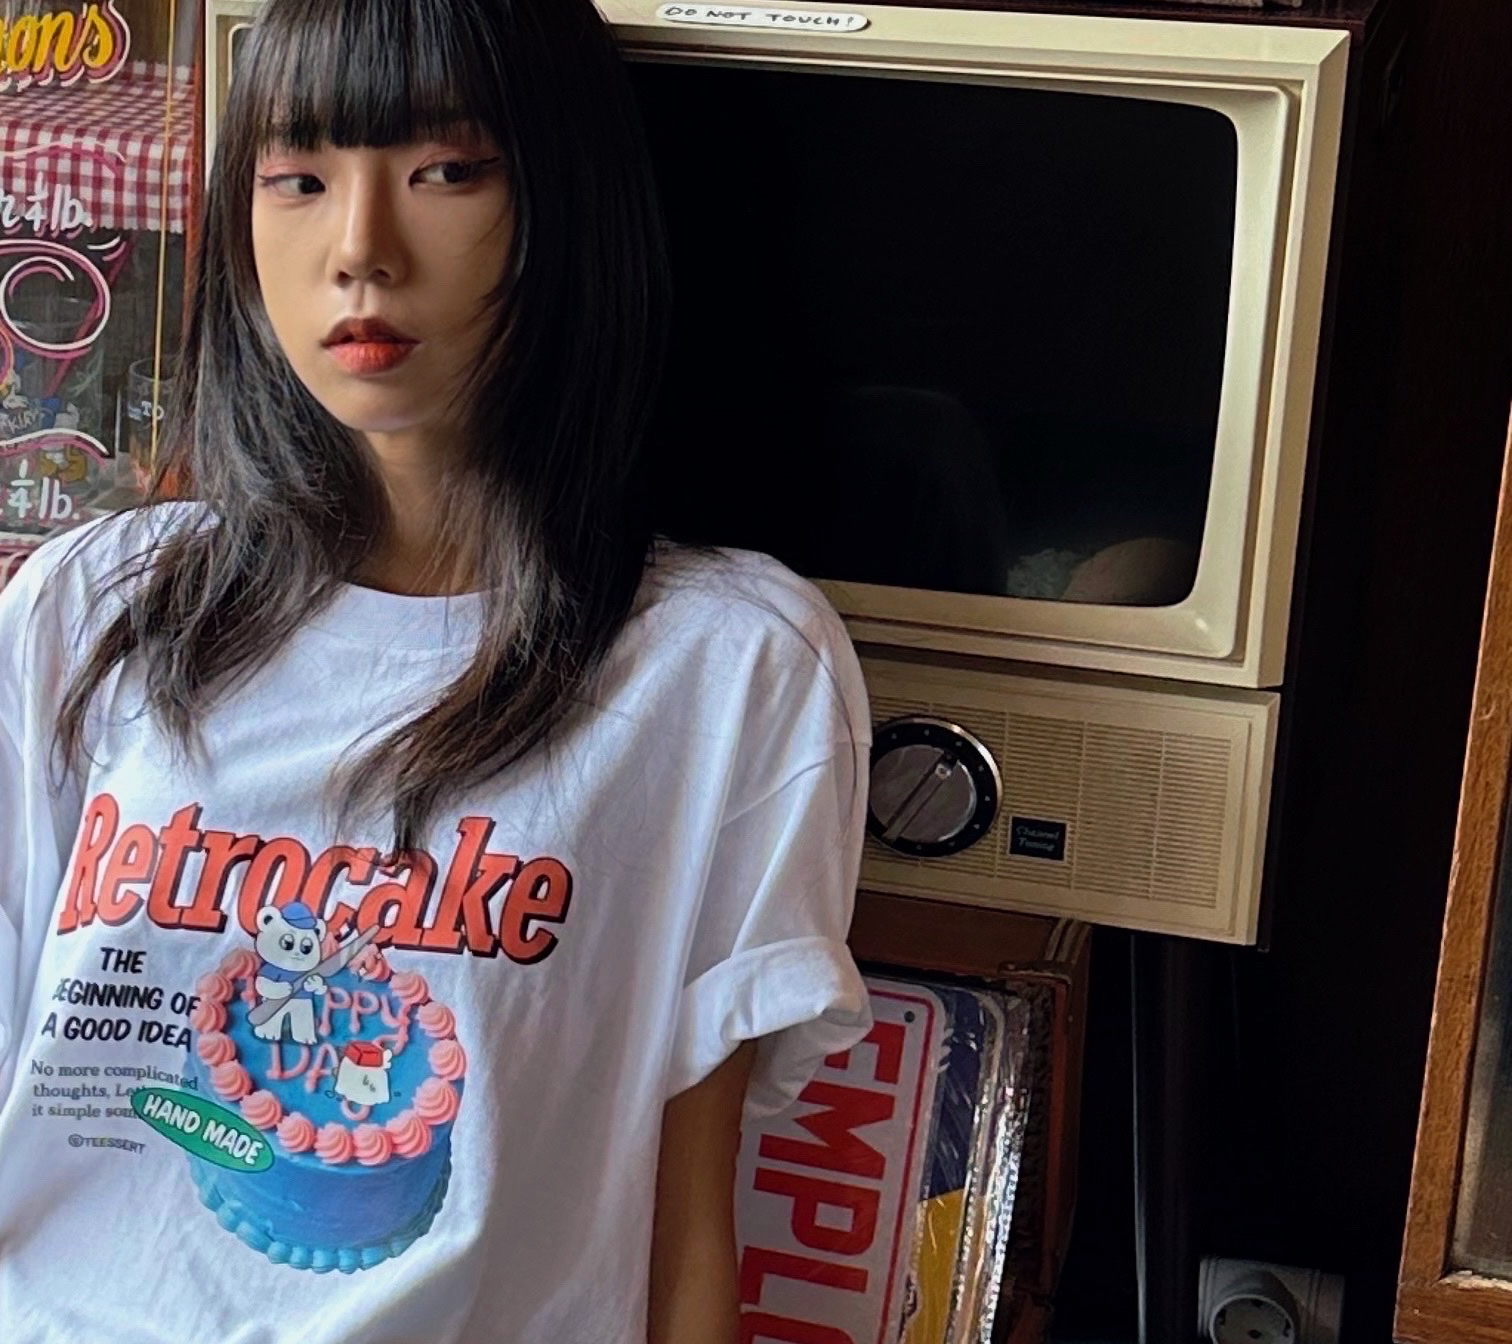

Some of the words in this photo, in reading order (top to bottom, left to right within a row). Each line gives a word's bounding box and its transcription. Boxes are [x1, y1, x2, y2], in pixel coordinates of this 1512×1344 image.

[665, 6, 697, 17] DO
[705, 10, 752, 21] NOT
[57, 793, 574, 965] Retrocake
[100, 946, 147, 974] THE
[170, 991, 201, 1018] OF
[41, 1012, 58, 1038] A
[63, 1016, 132, 1042] GOOD
[137, 1019, 193, 1053] IDEA
[31, 1059, 54, 1077] No
[58, 1066, 100, 1077] more
[104, 1065, 199, 1091] complicated
[32, 1104, 44, 1117] it
[48, 1104, 101, 1120] simple
[143, 1094, 201, 1134] HAND
[202, 1118, 264, 1166] MADE
